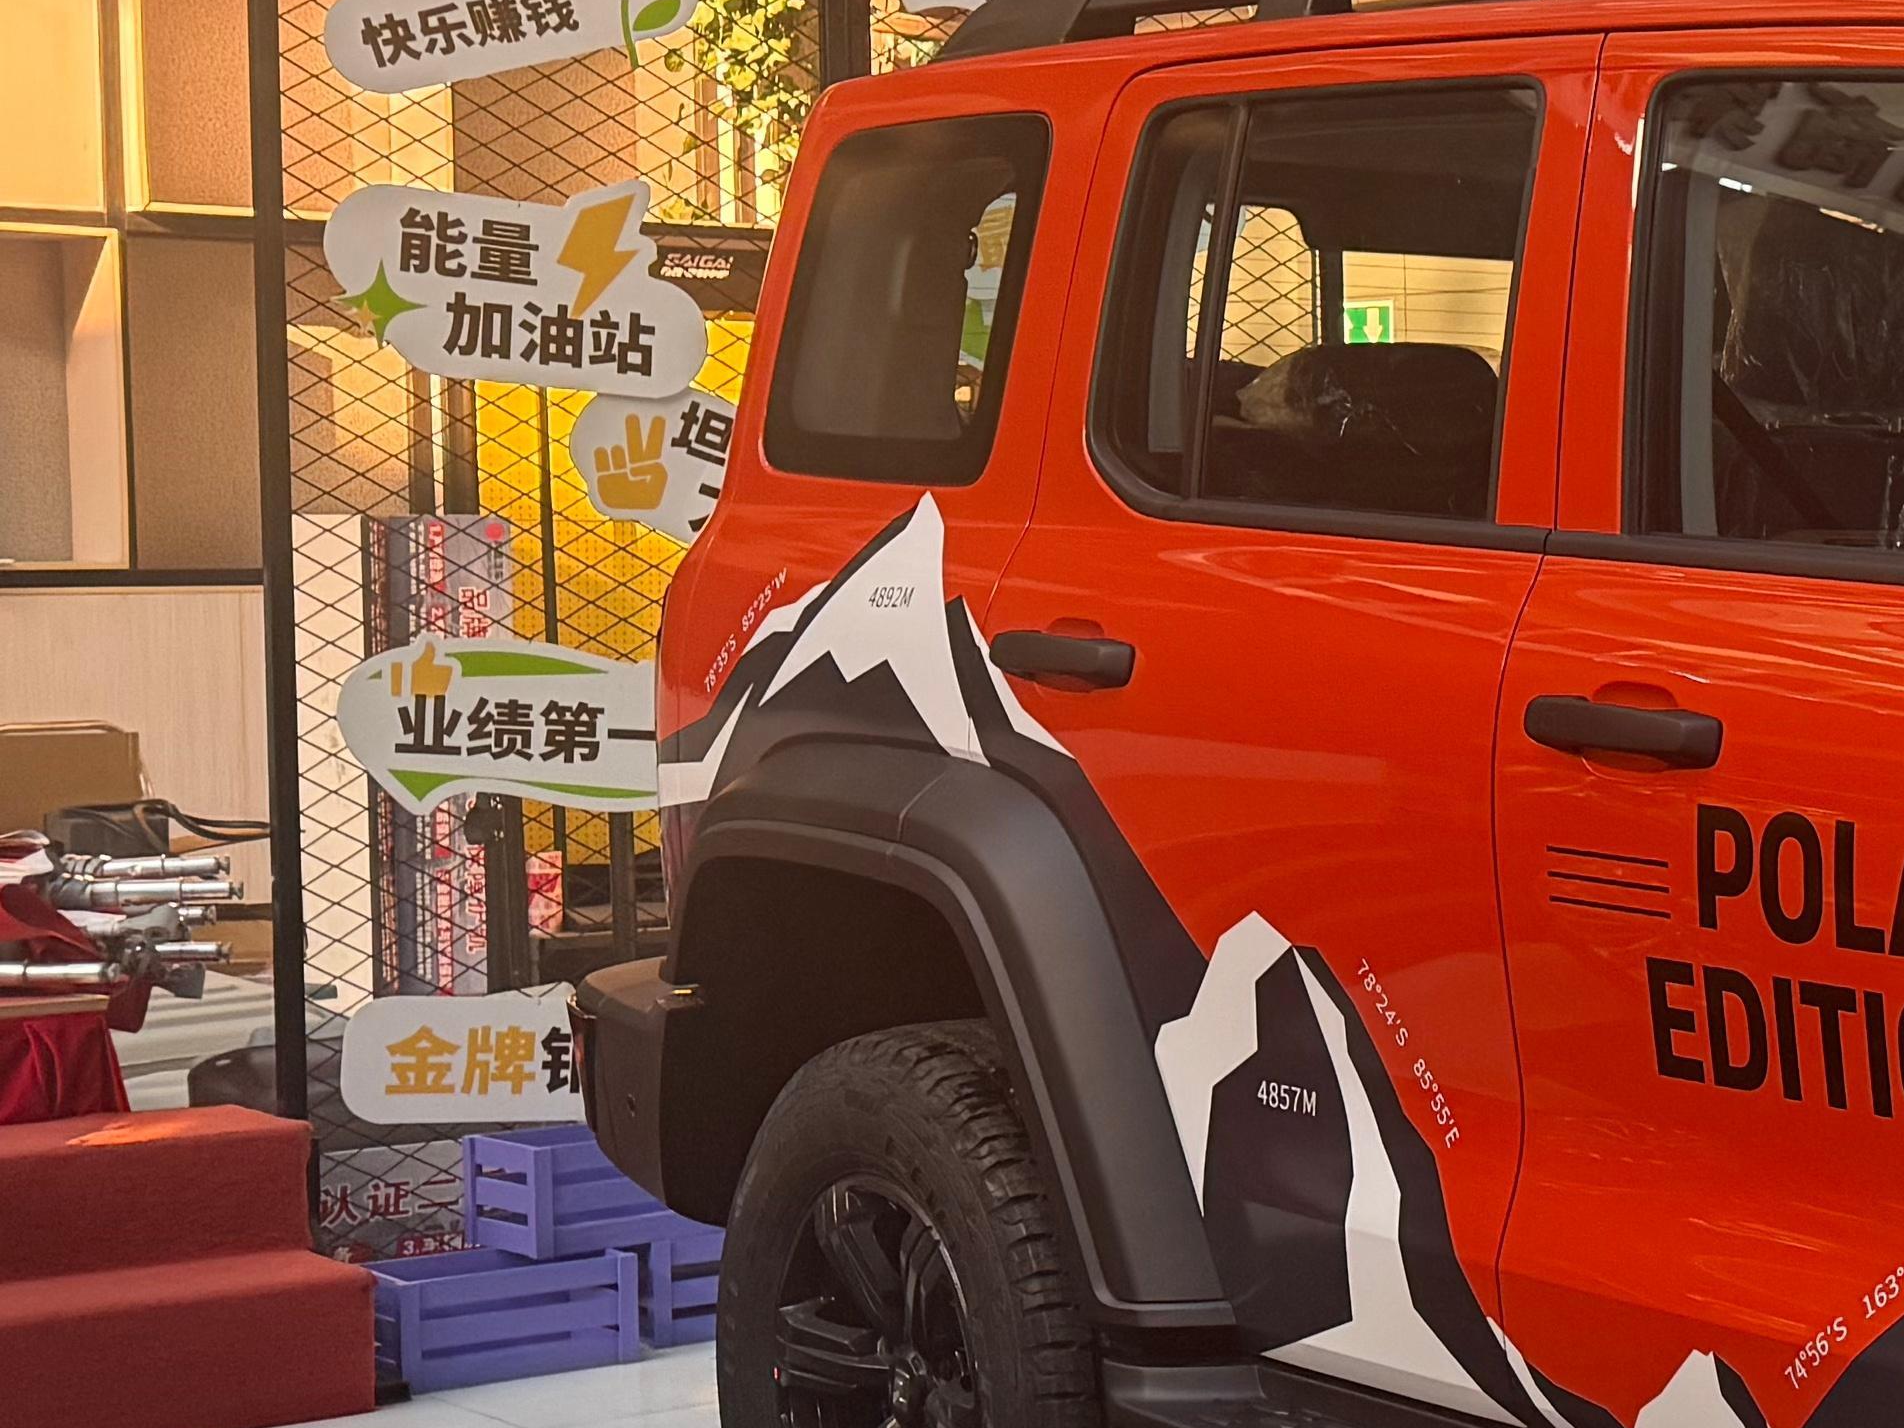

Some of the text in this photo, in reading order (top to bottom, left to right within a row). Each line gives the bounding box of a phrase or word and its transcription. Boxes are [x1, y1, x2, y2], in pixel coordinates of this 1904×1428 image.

[397, 206, 541, 288] 能量
[442, 292, 655, 378] 加油站
[868, 586, 915, 608] 4892M
[394, 695, 657, 765] 业绩第一
[1356, 958, 1461, 1149] 78°24'S 85°55'E
[1257, 1080, 1318, 1118] 4857M
[1783, 1316, 1850, 1390] 74°56'S
